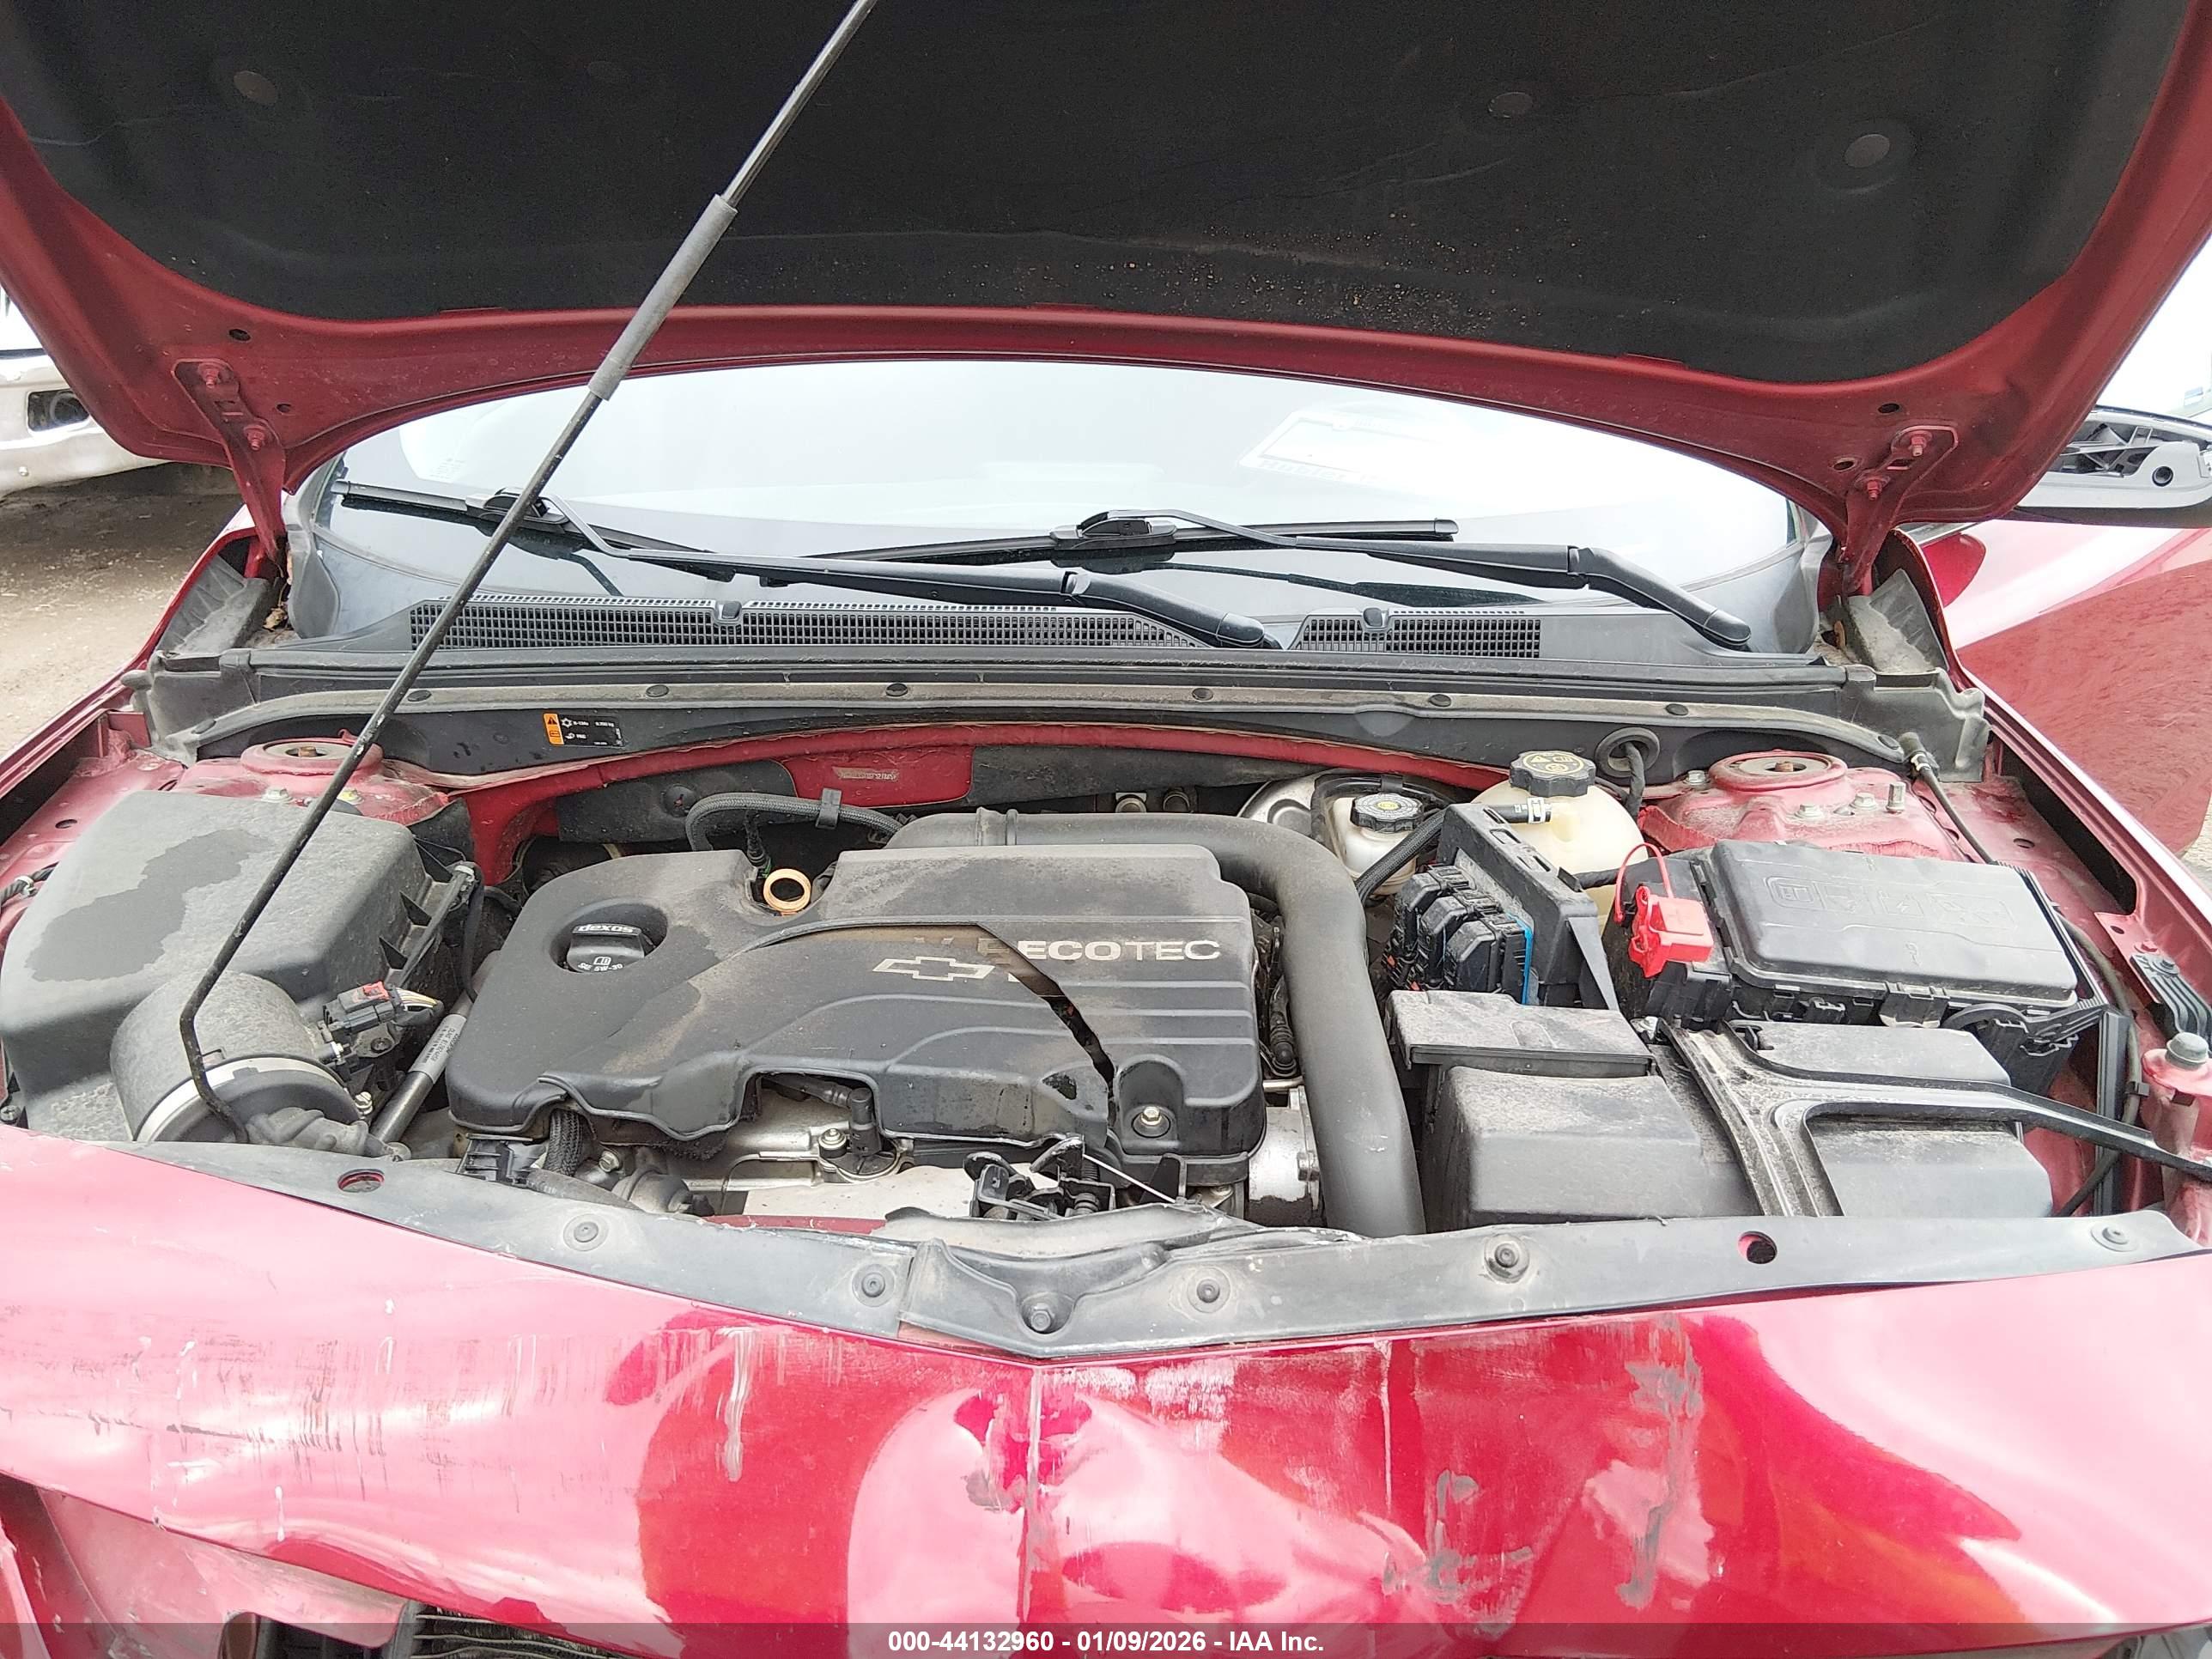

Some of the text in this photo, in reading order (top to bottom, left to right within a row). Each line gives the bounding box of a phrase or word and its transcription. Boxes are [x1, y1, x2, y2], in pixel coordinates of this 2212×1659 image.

[577, 923, 634, 933] dexos
[1018, 940, 1221, 961] ECOTEC
[577, 962, 623, 972] SAE 5W-30
